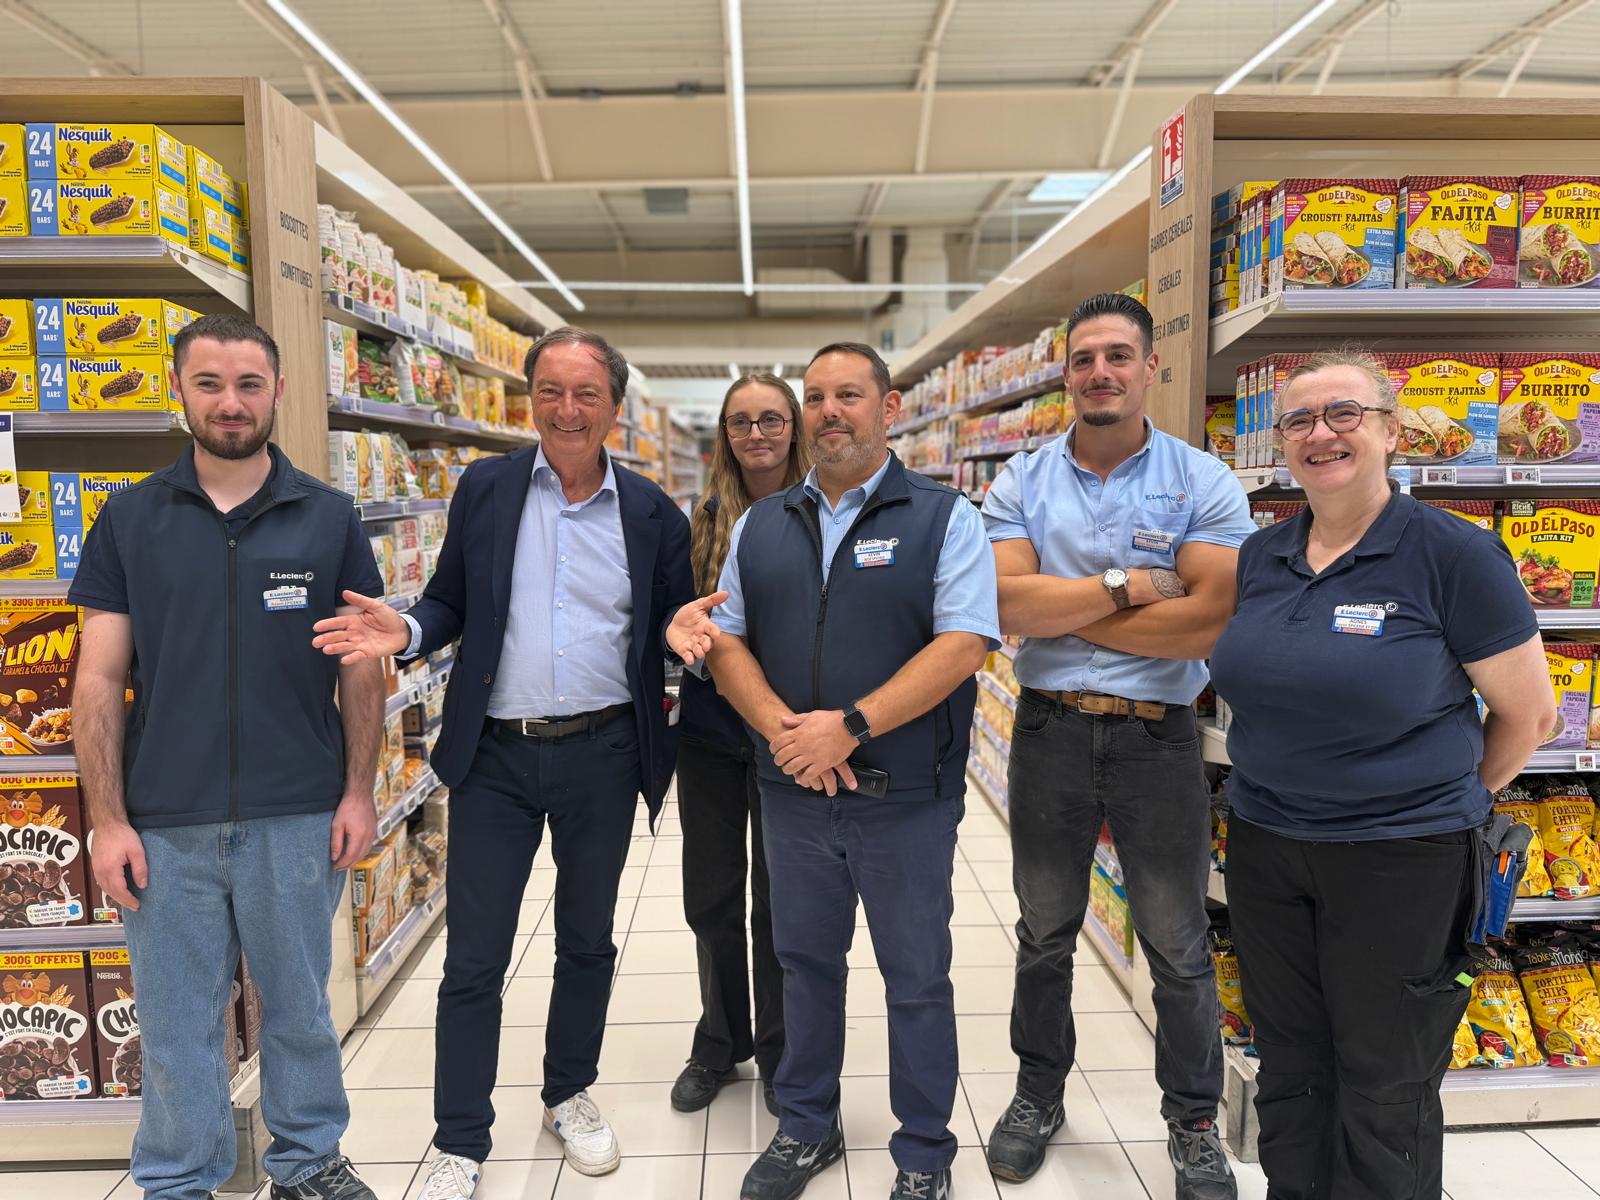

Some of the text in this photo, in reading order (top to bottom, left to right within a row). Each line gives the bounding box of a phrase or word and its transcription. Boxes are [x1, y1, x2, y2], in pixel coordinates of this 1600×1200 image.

[28, 131, 52, 155] 24
[58, 127, 112, 144] Nesquik
[31, 188, 53, 212] 24
[60, 184, 113, 201] Nesquik
[1346, 213, 1383, 222] FAJITAS
[1430, 205, 1497, 222] FAJITA
[1542, 206, 1600, 220] BURRIT
[280, 210, 309, 241] BISCOTTES
[1168, 213, 1193, 243] CÉRÉALES
[281, 261, 313, 289] CONFITURES
[1158, 269, 1182, 295] CÉRÉALES
[37, 306, 60, 330] 24
[66, 302, 120, 319] Nesquik
[40, 363, 63, 387] 24
[69, 359, 122, 376] Nesquik
[1161, 367, 1173, 384] MIEL
[1403, 387, 1486, 396] CROUSTI' FAJITAS
[1520, 384, 1590, 397] BURRITO
[54, 482, 77, 505] 24
[1511, 520, 1539, 538] OLD
[1541, 517, 1558, 532] EL
[58, 534, 80, 557] 24
[1533, 534, 1573, 542] FAJITA KIT
[12, 599, 33, 607] 330G
[36, 599, 68, 607] OFFER
[5, 623, 77, 666] LION
[30, 663, 71, 674] CHOCOLAT
[4, 954, 81, 965] 300G OFFERTS
[92, 951, 119, 960] 700G
[1533, 973, 1583, 988] TORTILLAS
[1537, 985, 1568, 999] CHIPS
[32, 1027, 51, 1035] CHOCOLAT
